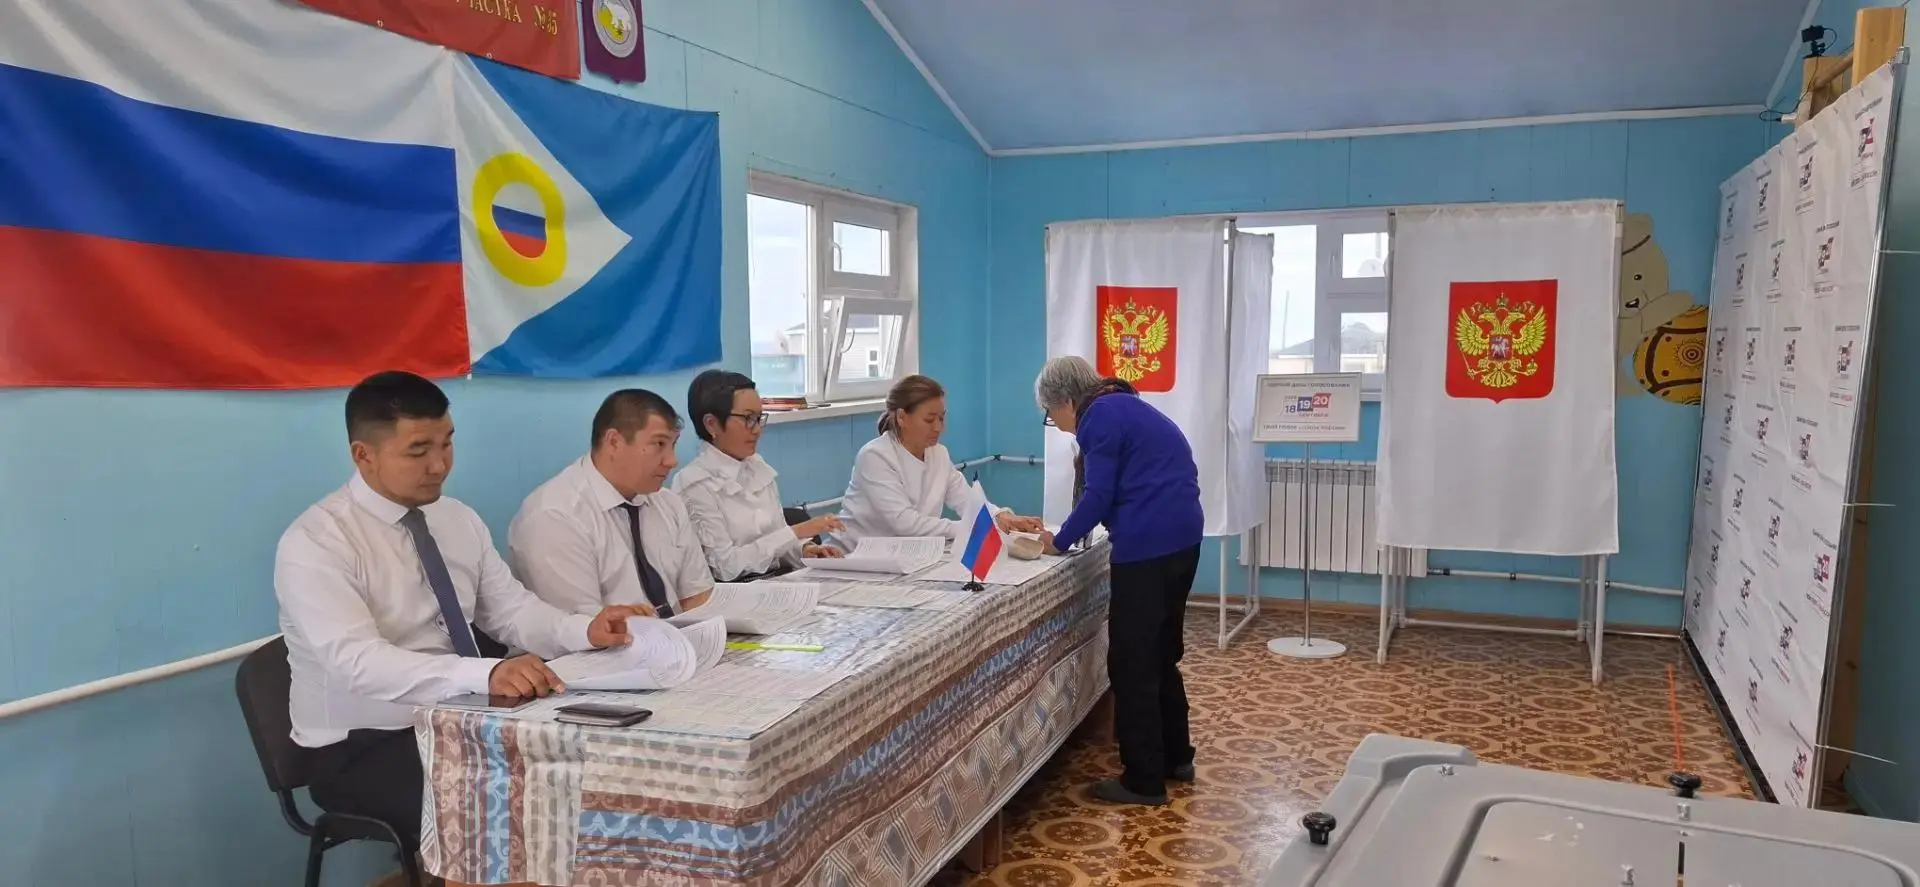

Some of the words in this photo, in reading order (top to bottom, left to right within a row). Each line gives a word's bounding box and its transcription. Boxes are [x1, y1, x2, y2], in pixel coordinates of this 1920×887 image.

[1285, 405, 1296, 413] 18
[1299, 400, 1311, 409] 19
[1312, 396, 1329, 405] 20
